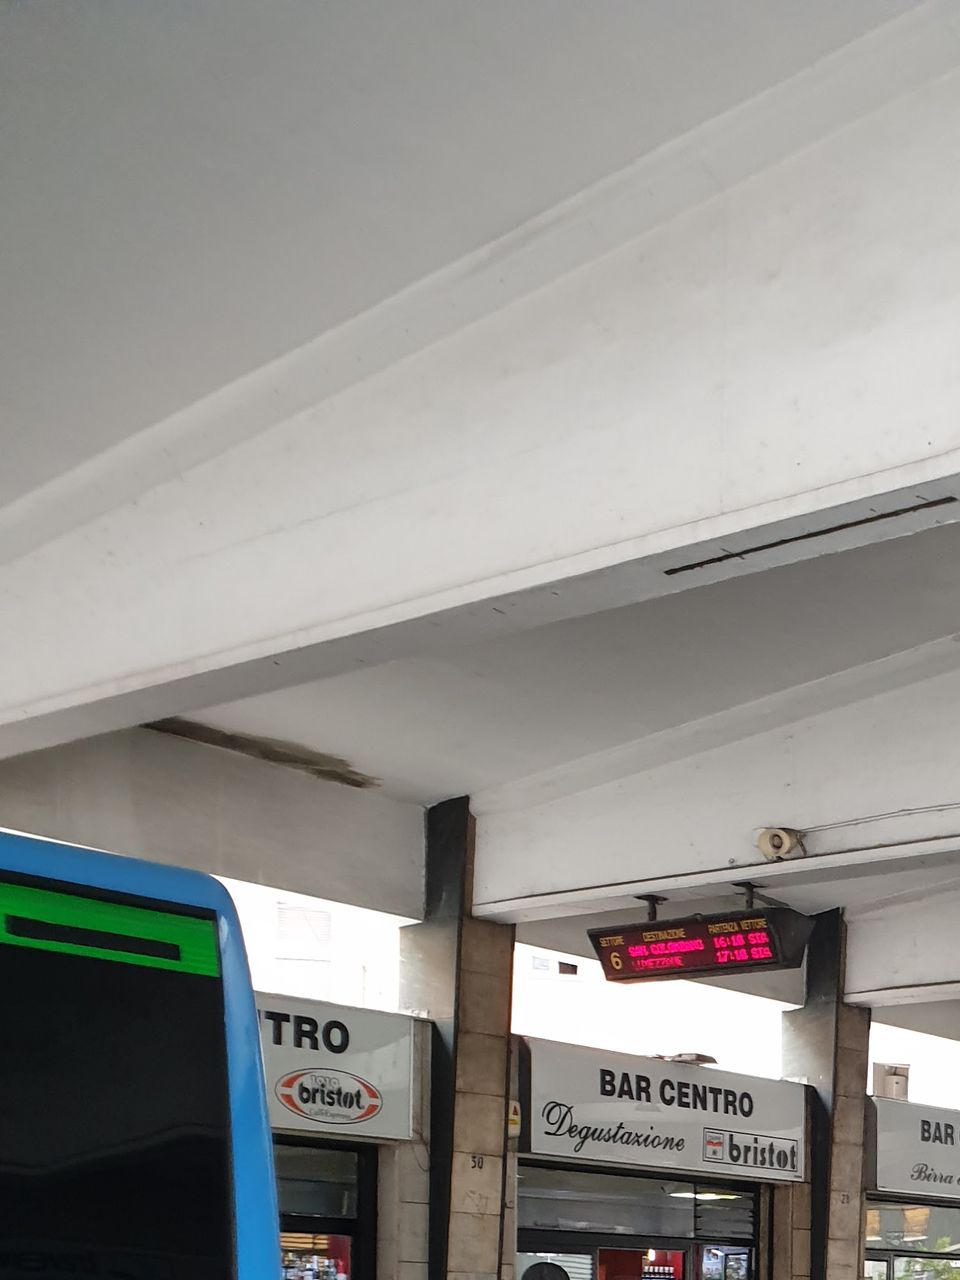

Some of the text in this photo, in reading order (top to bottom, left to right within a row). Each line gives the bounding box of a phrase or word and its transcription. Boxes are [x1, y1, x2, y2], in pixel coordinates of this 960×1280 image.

[643, 928, 686, 942] DESTINAZIONE
[708, 921, 739, 934] PARTENZA
[740, 918, 769, 931] VETTORE
[600, 936, 625, 947] SETTORE
[610, 952, 622, 970] 6
[258, 1009, 350, 1055] TRO
[298, 1081, 365, 1110] bristot
[599, 1068, 754, 1118] BAR CENTRO
[541, 1101, 686, 1153] Degustazione
[920, 1119, 955, 1146] BAR
[728, 1133, 796, 1170] bristot
[910, 1162, 954, 1184] Birra
